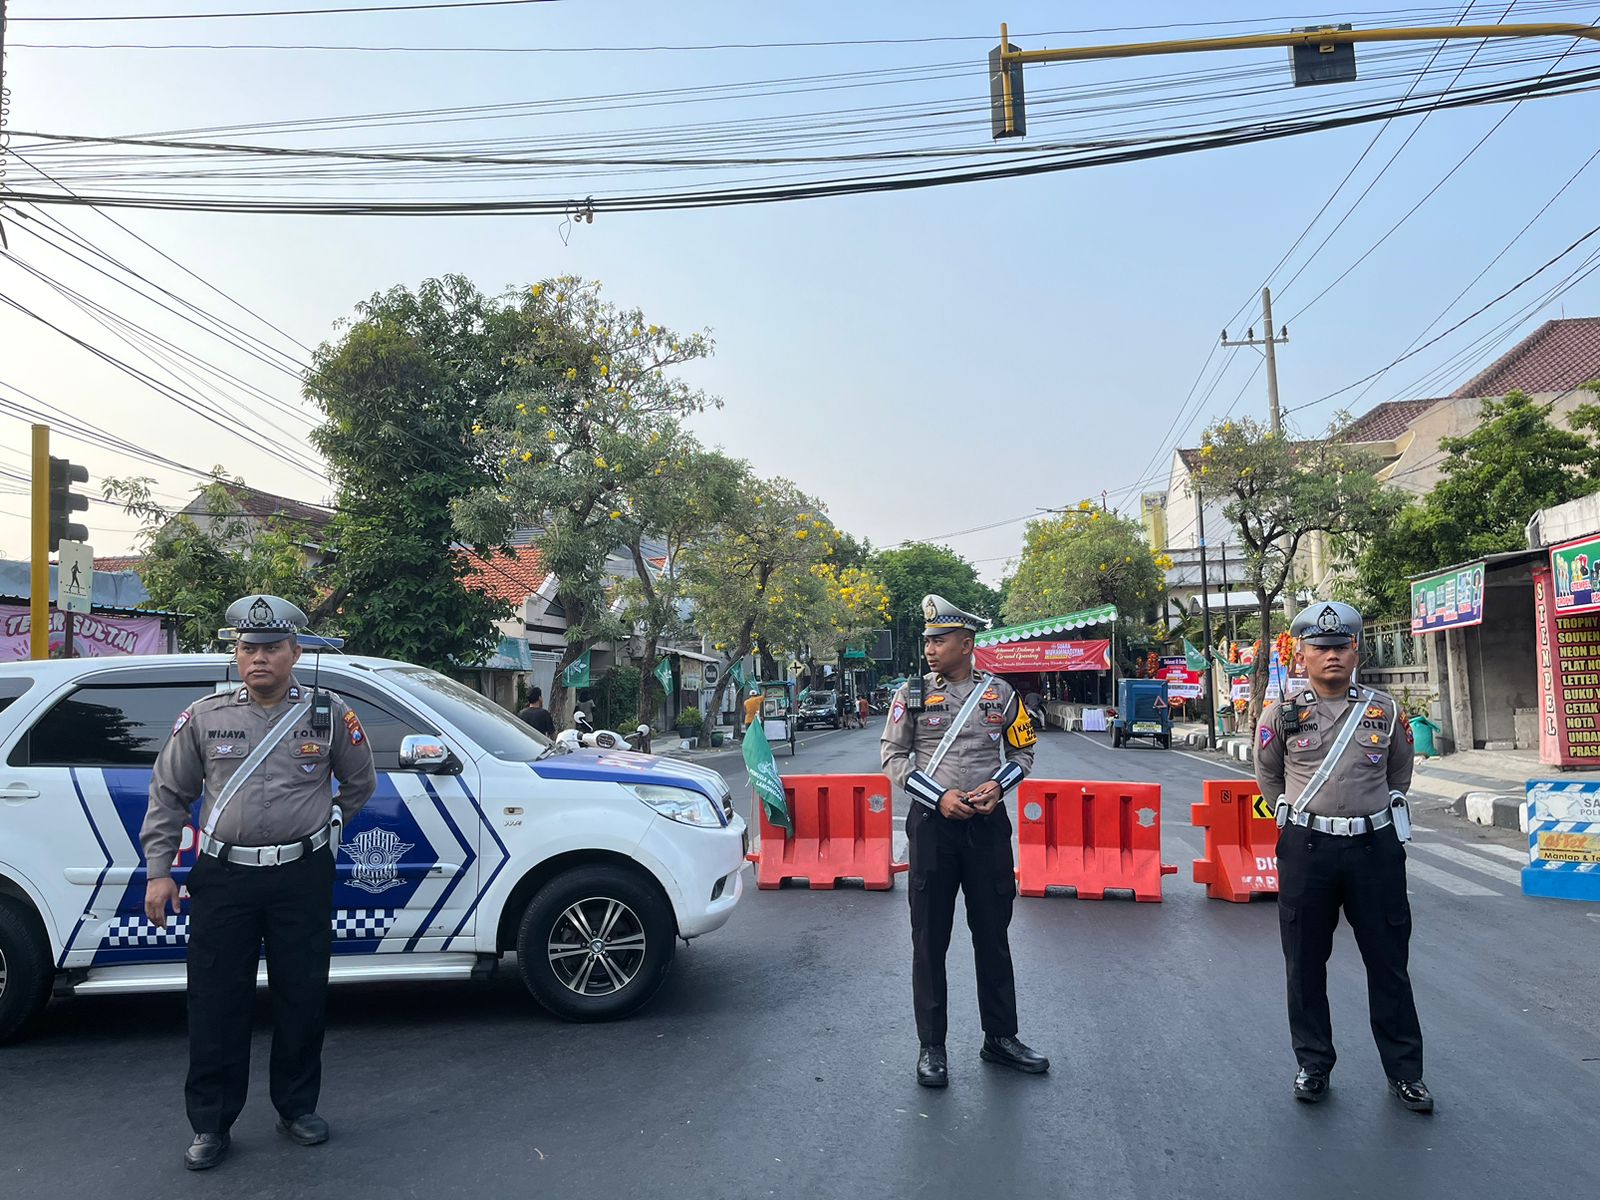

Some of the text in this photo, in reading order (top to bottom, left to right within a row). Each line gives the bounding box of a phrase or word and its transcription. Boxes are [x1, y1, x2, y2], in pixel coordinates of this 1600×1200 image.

[1556, 617, 1598, 629] TROPHY
[6, 611, 138, 653] TER SULTAN
[1559, 646, 1588, 657] NEON
[1536, 582, 1556, 736] STEMPEL
[1561, 660, 1586, 672] PLAT
[1562, 674, 1598, 686] LETTER
[1564, 689, 1593, 700] BUKU
[979, 703, 1003, 711] POLR
[1565, 703, 1598, 714] CETAK
[1567, 717, 1594, 729] NOTA
[208, 730, 246, 740] WIJAYA
[1544, 852, 1580, 862] Mantap
